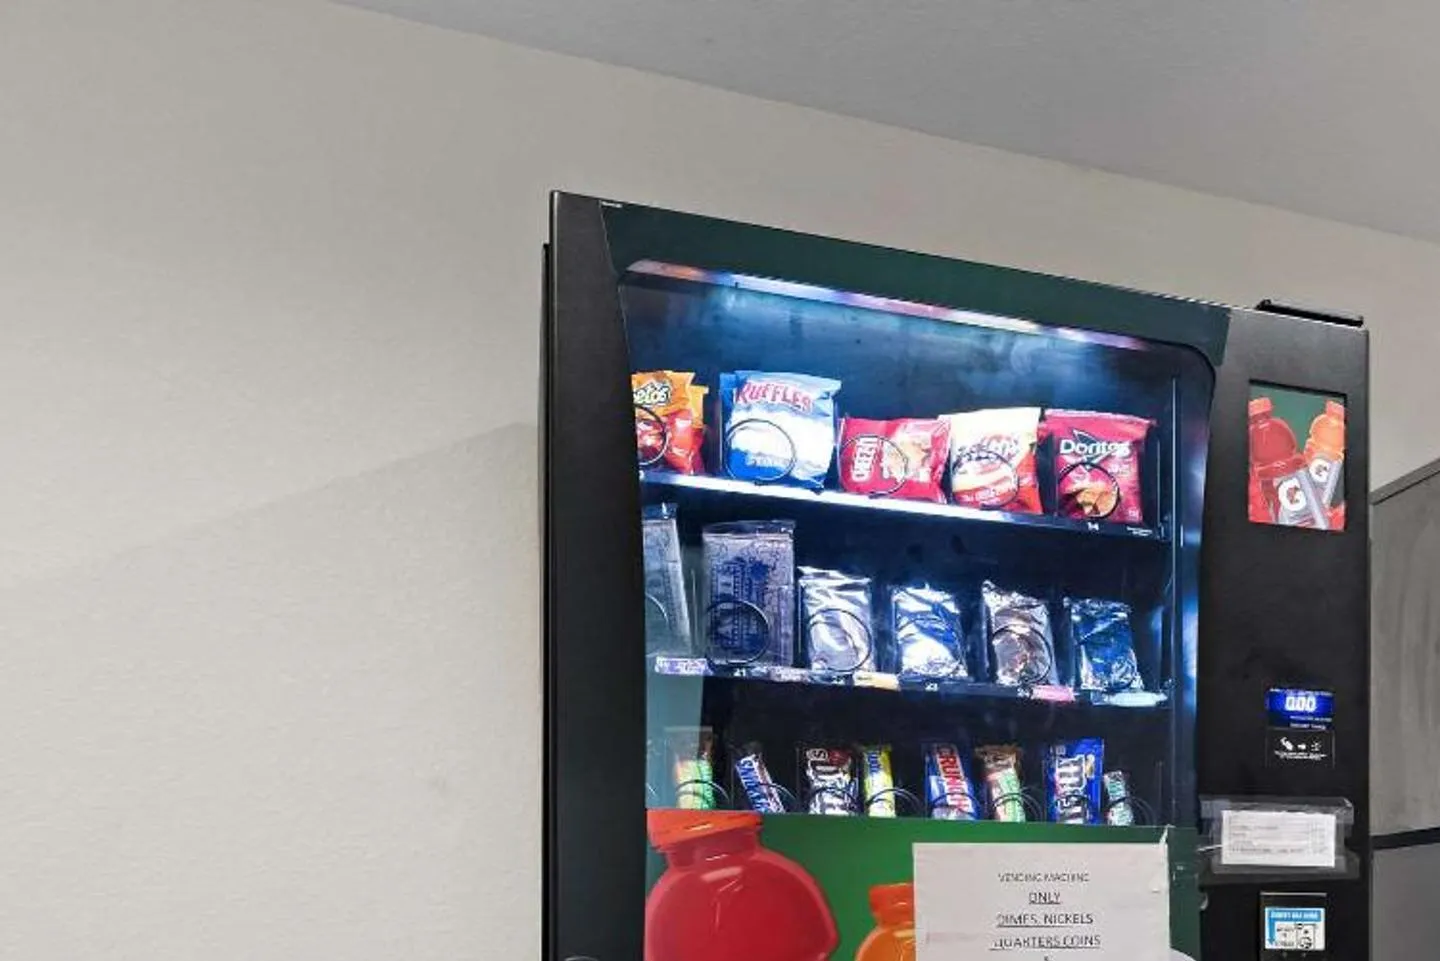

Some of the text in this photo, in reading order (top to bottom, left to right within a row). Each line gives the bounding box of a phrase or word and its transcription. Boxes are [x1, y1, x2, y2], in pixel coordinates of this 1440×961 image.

[735, 382, 815, 412] RUFFLES
[1060, 438, 1130, 456] Doritos
[1029, 892, 1061, 905] ONLY
[1043, 913, 1094, 925] NICKELS
[1063, 934, 1101, 948] COINS
